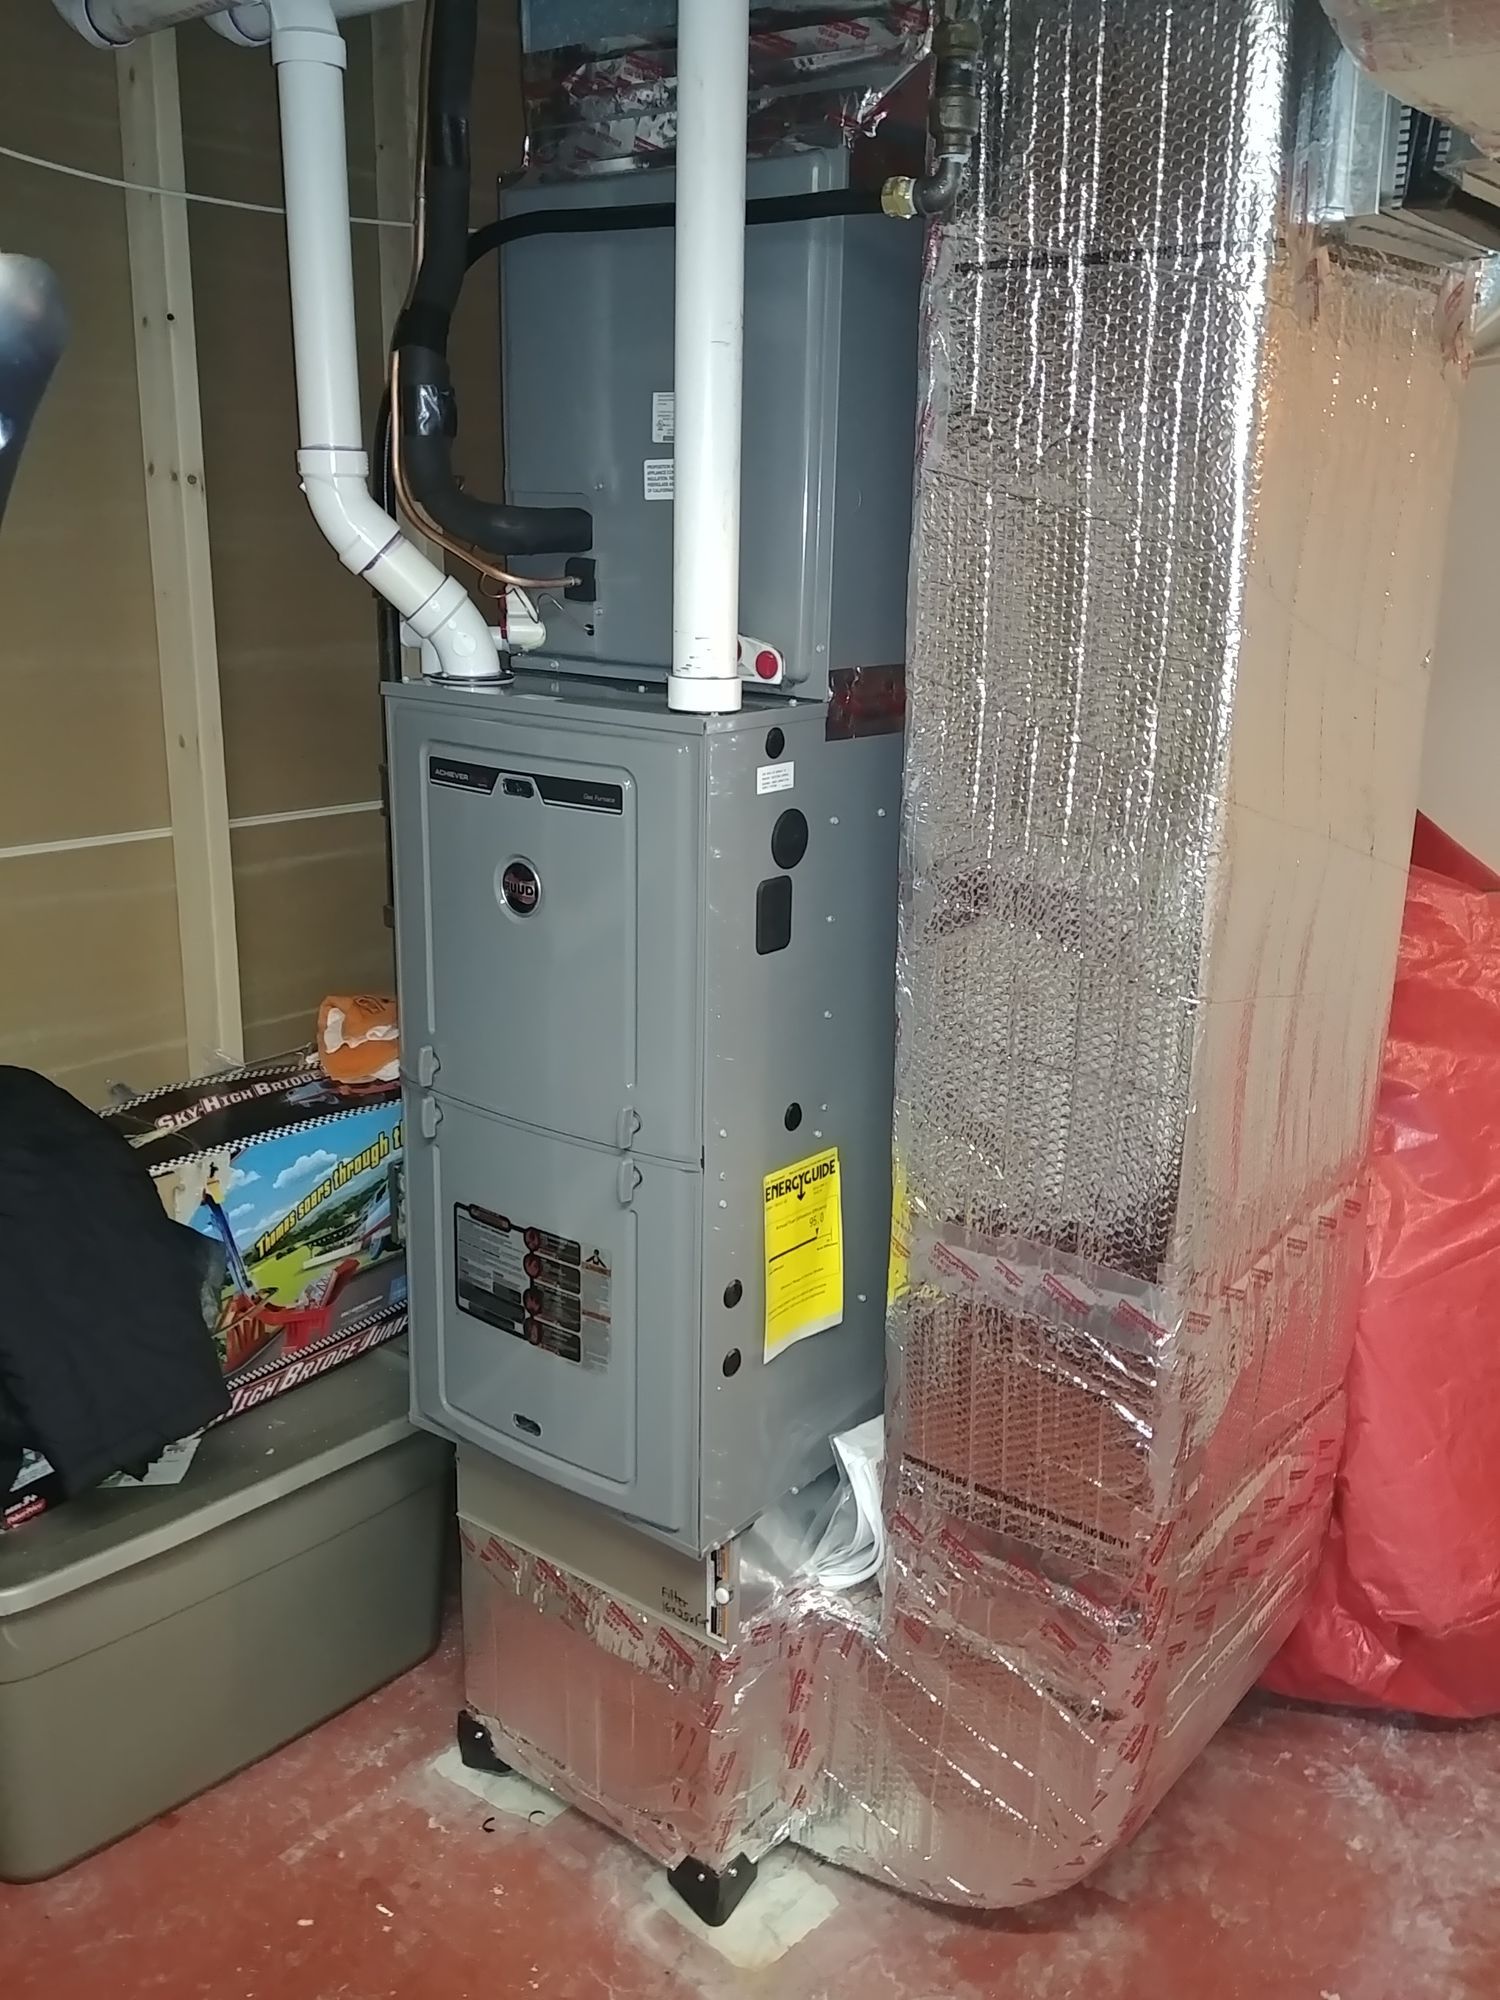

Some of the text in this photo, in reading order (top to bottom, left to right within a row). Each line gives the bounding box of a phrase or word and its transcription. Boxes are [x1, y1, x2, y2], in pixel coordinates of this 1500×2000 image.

[435, 768, 470, 782] ACHIEVER
[256, 1071, 322, 1097] BRIDGE
[256, 1210, 297, 1259] Thomas
[297, 1178, 332, 1220] soars
[332, 1131, 390, 1190] through
[765, 1158, 836, 1203] ENERGYGUIDE
[279, 1340, 361, 1393] BRIDGE
[661, 1586, 689, 1607] Filter
